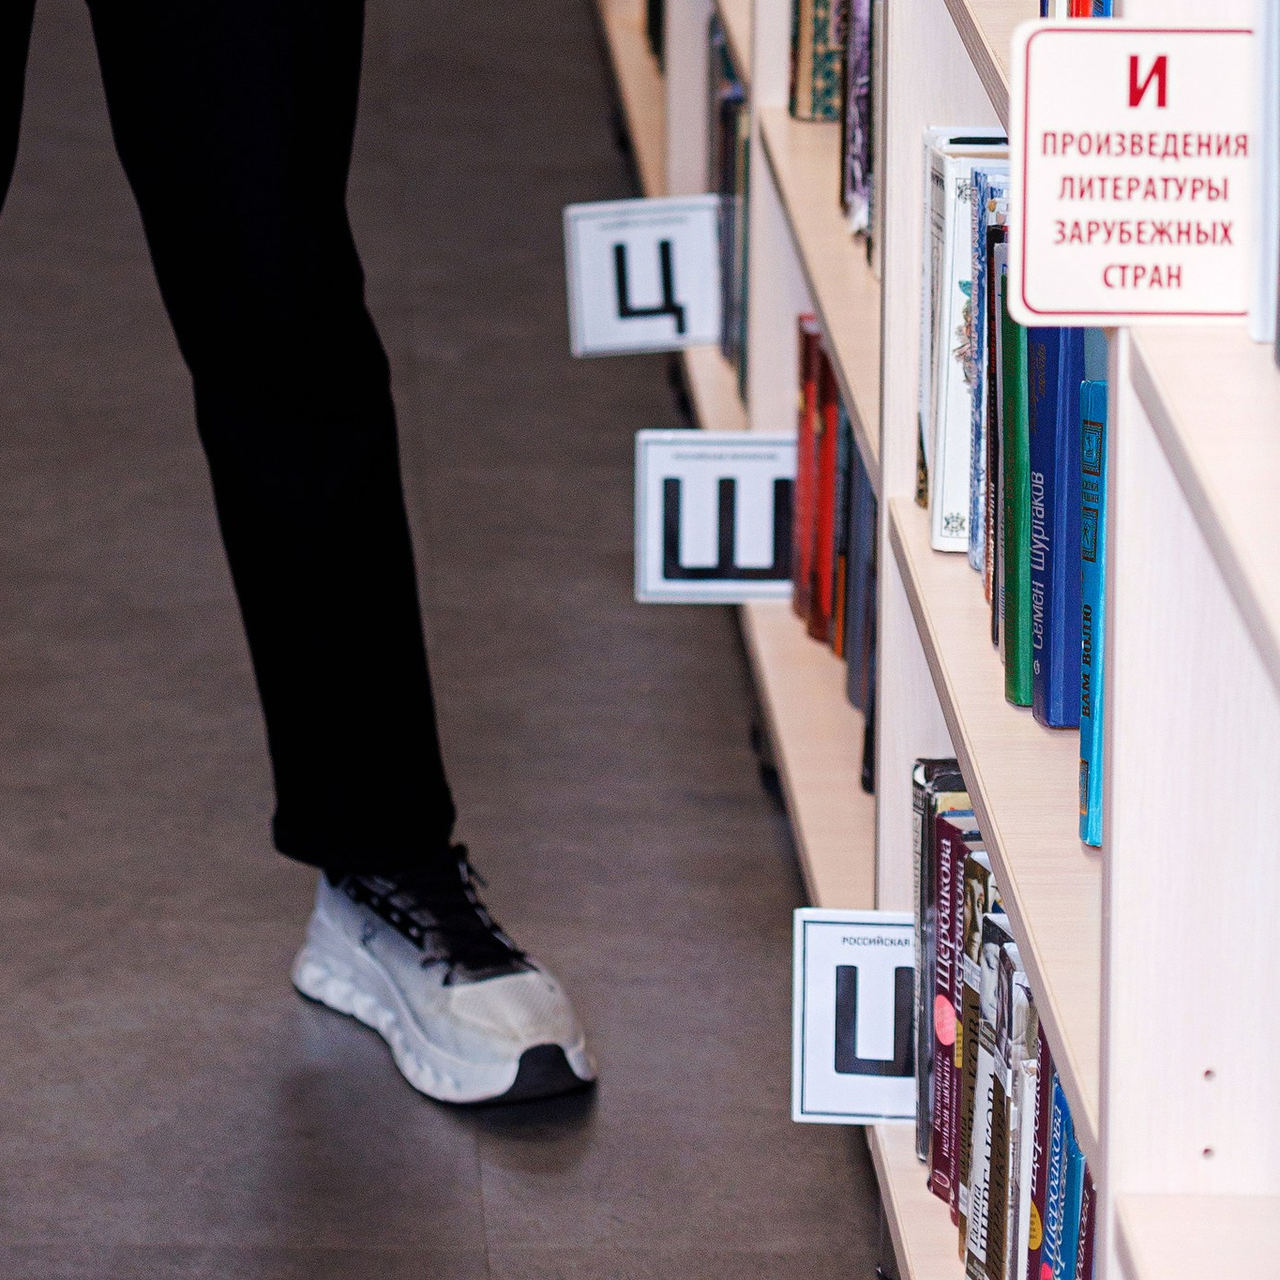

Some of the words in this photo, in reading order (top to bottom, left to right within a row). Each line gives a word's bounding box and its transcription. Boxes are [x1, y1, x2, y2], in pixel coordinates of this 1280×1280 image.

[1128, 54, 1167, 107] И
[1042, 131, 1248, 160] ПРОИЗВЕДЕНИЯ
[1059, 177, 1229, 201] ЛИТЕРАТУРЫ
[1053, 220, 1234, 246] ЗАРУБЕЖНЫХ
[614, 238, 685, 334] Ц
[1103, 264, 1183, 289] СТРАН
[662, 477, 793, 580] Ш
[1030, 471, 1049, 573] Шуртаков
[1082, 603, 1092, 667] ВОЛЮ
[1081, 673, 1092, 720] ВАМ
[937, 838, 954, 992] Щербакова
[1044, 1103, 1062, 1261] Щербакова
[969, 1184, 981, 1248] Галина
